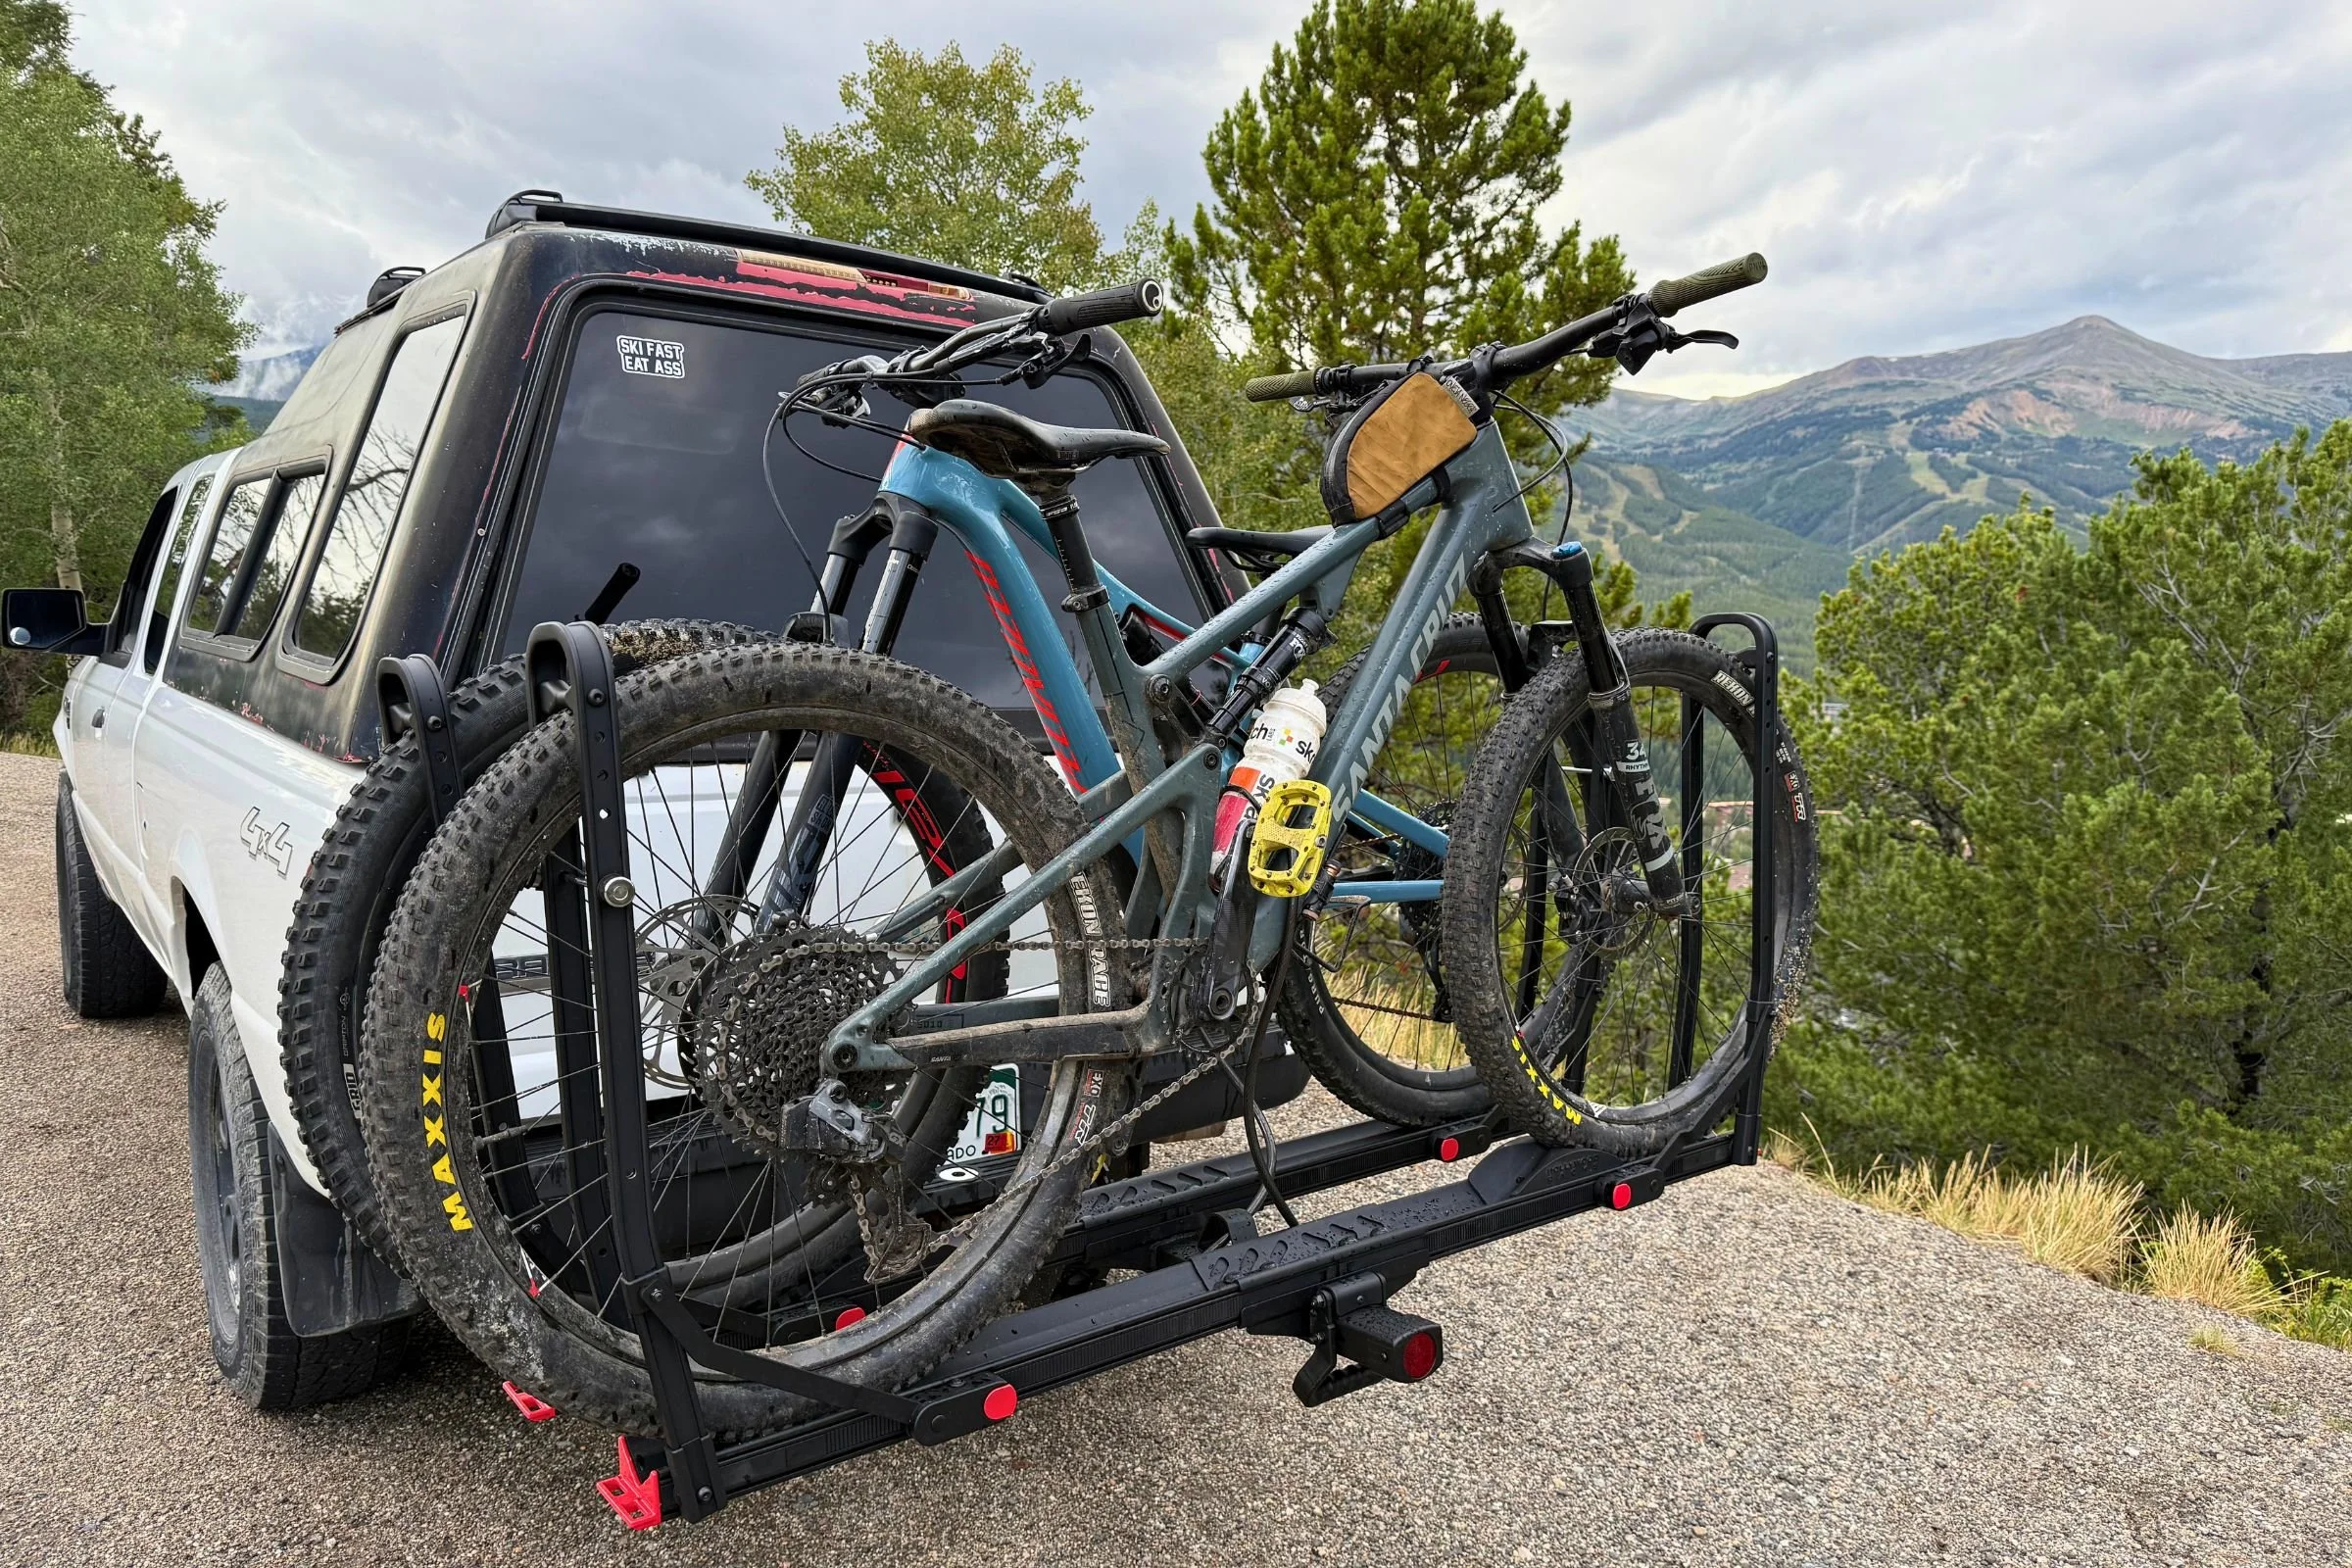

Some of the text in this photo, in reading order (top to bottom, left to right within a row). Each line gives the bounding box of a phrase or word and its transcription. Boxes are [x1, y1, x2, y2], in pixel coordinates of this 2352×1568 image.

[619, 338, 681, 361] SKI FAST
[624, 355, 682, 376] EAT ASS
[1712, 670, 1755, 707] REKON
[1626, 741, 1647, 760] 34
[239, 806, 293, 878] 4x4
[1511, 1035, 1582, 1126] MAXXIS
[422, 1011, 473, 1232] MAXXIS
